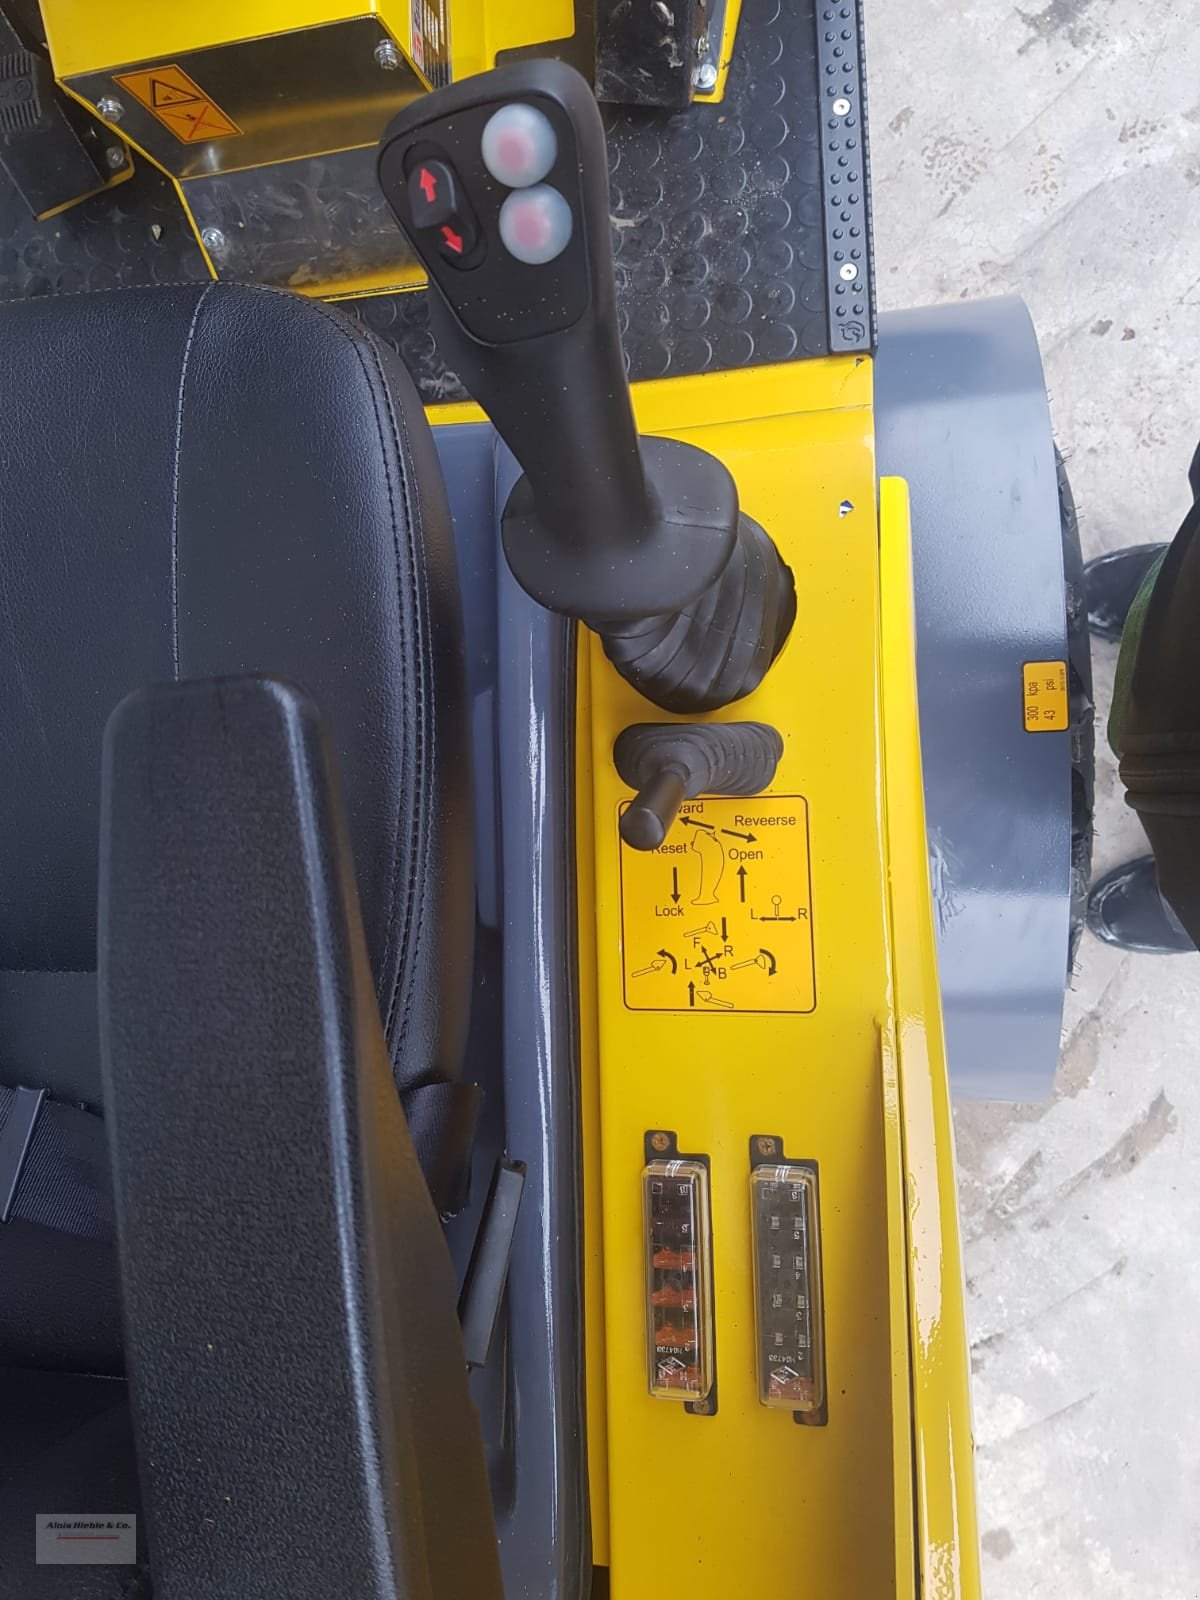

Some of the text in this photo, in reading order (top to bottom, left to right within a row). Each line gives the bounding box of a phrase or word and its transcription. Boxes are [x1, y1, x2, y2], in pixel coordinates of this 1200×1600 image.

[1026, 681, 1040, 721] 300 kpa
[1043, 678, 1058, 721] 43 psi
[734, 814, 797, 827] Reveerse
[728, 847, 764, 863] Open
[655, 904, 685, 917] Lock
[750, 908, 759, 920] L
[798, 908, 808, 920] R
[693, 936, 701, 948] F
[724, 945, 734, 957] R
[684, 958, 692, 970] L
[718, 968, 728, 980] B
